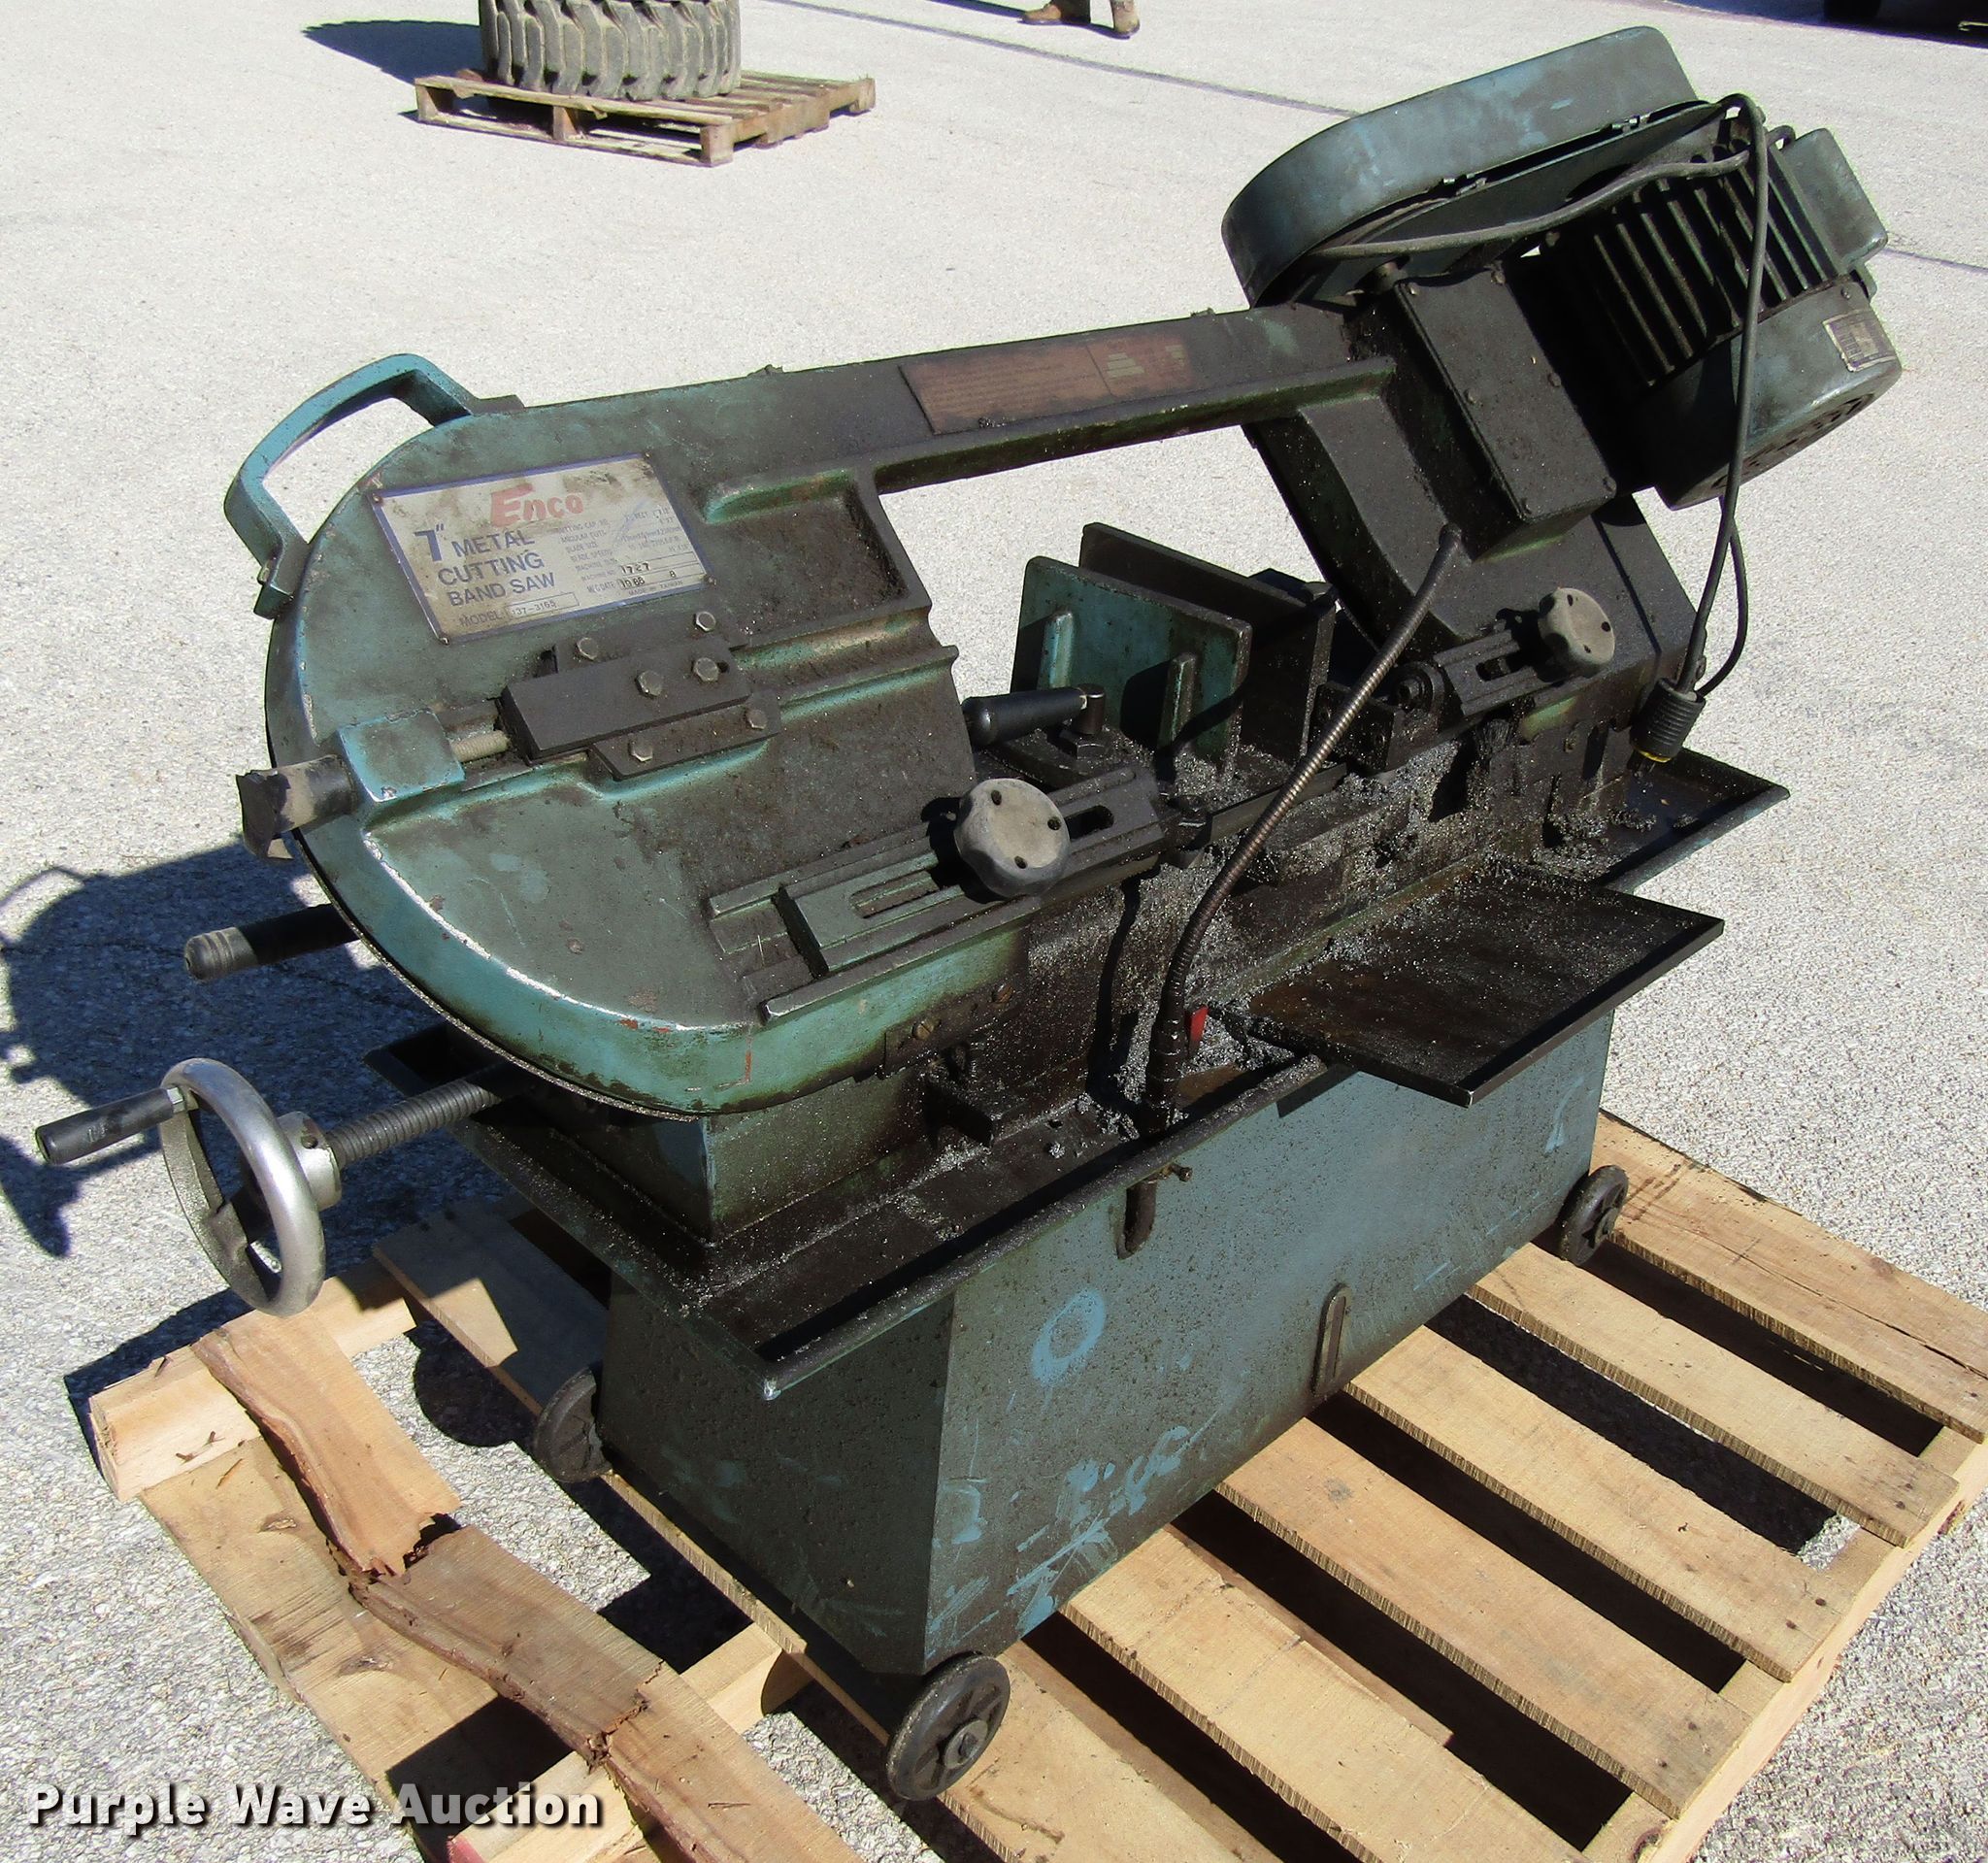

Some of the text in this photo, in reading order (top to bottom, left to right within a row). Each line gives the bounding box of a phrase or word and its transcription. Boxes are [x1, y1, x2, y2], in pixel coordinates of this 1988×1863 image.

[490, 482, 583, 528] Enco
[451, 529, 535, 557] METAL
[438, 552, 545, 585] CUTTING
[621, 562, 650, 574] 1727
[447, 572, 555, 606] BAND SAW
